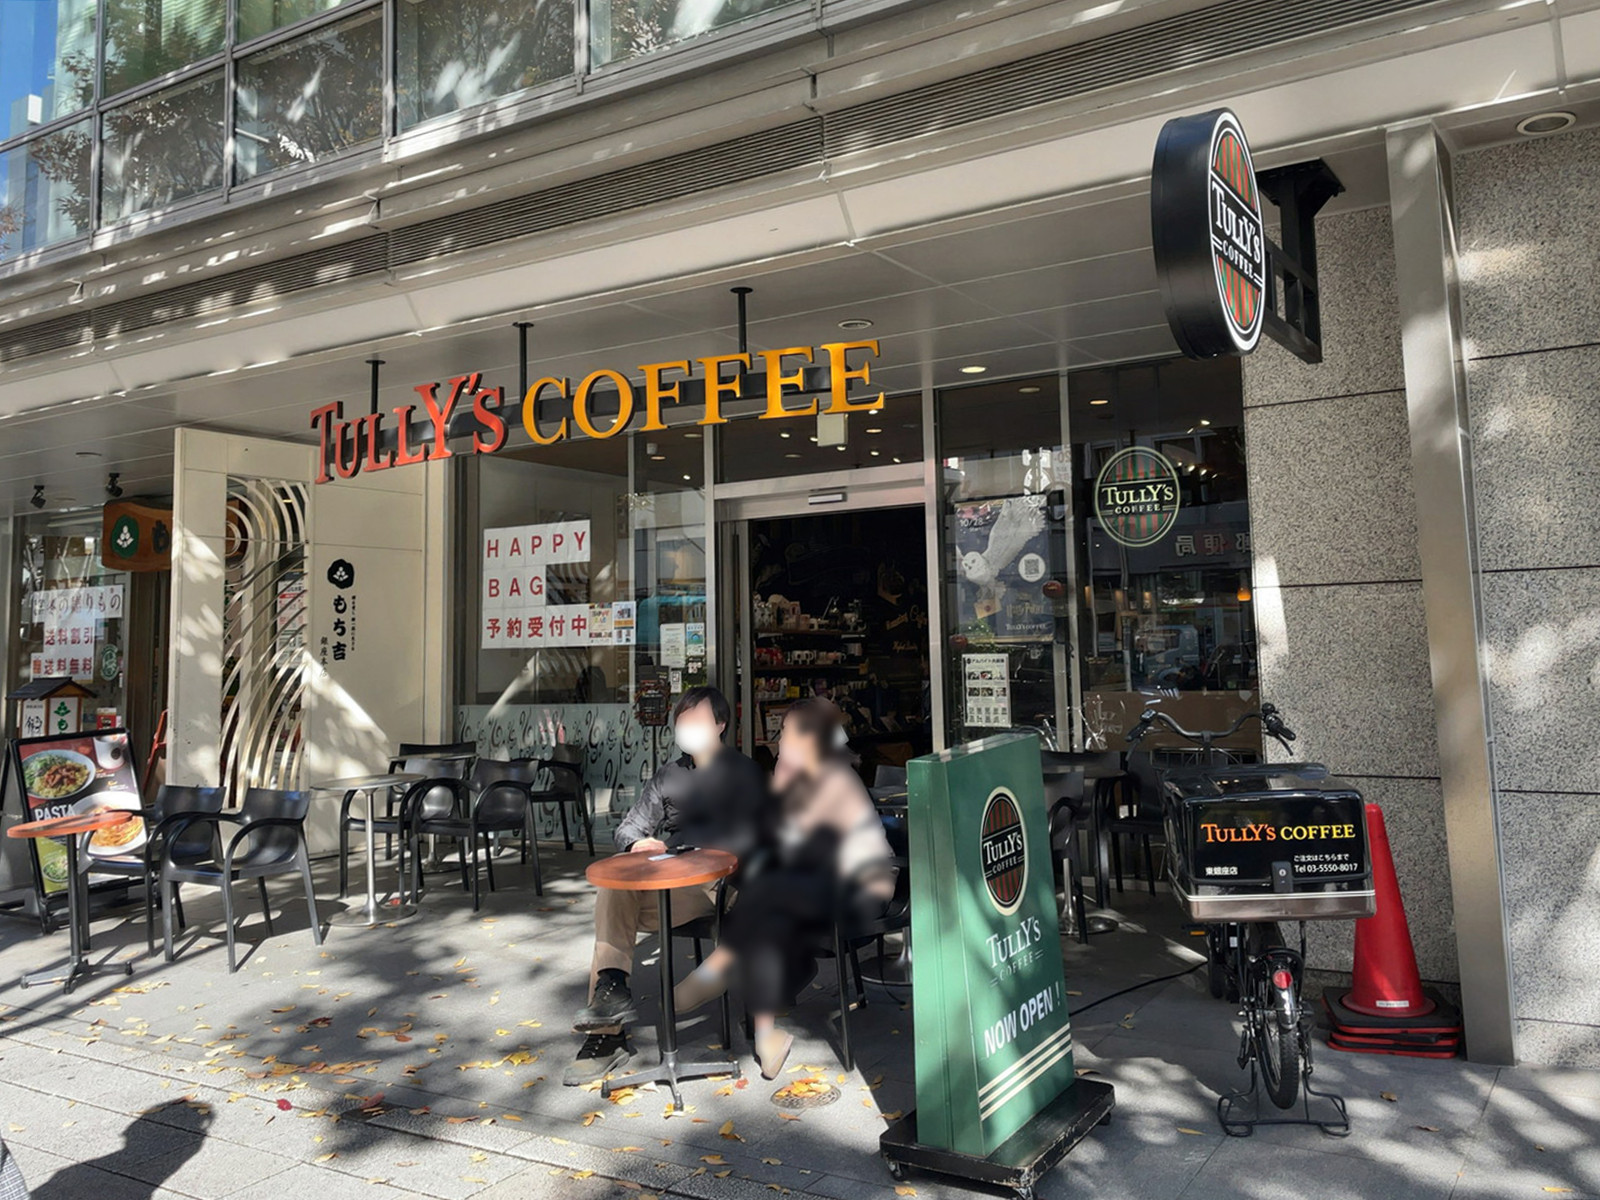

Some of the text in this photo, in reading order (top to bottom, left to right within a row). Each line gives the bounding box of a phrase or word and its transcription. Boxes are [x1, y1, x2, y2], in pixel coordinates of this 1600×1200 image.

[1222, 240, 1254, 279] COFFEE
[522, 339, 886, 445] COFFEE
[1114, 504, 1161, 514] COFFEE
[486, 531, 586, 558] HAPPY
[488, 576, 543, 598] BAG
[45, 626, 93, 646] 送料割引
[332, 595, 347, 661] もち吉
[486, 614, 587, 639] 予約受付中
[44, 657, 92, 675] 送料無料
[34, 804, 76, 822] PASTA
[1280, 824, 1356, 841] COFFEE
[992, 855, 1018, 875] COFFEE
[1294, 853, 1350, 862] ご注文はこちらまで
[1294, 863, 1359, 873] Tel 03-5550-8017
[1000, 951, 1034, 982] COFFEE
[984, 1013, 1018, 1058] NOW
[1020, 988, 1054, 1032] OPEN
